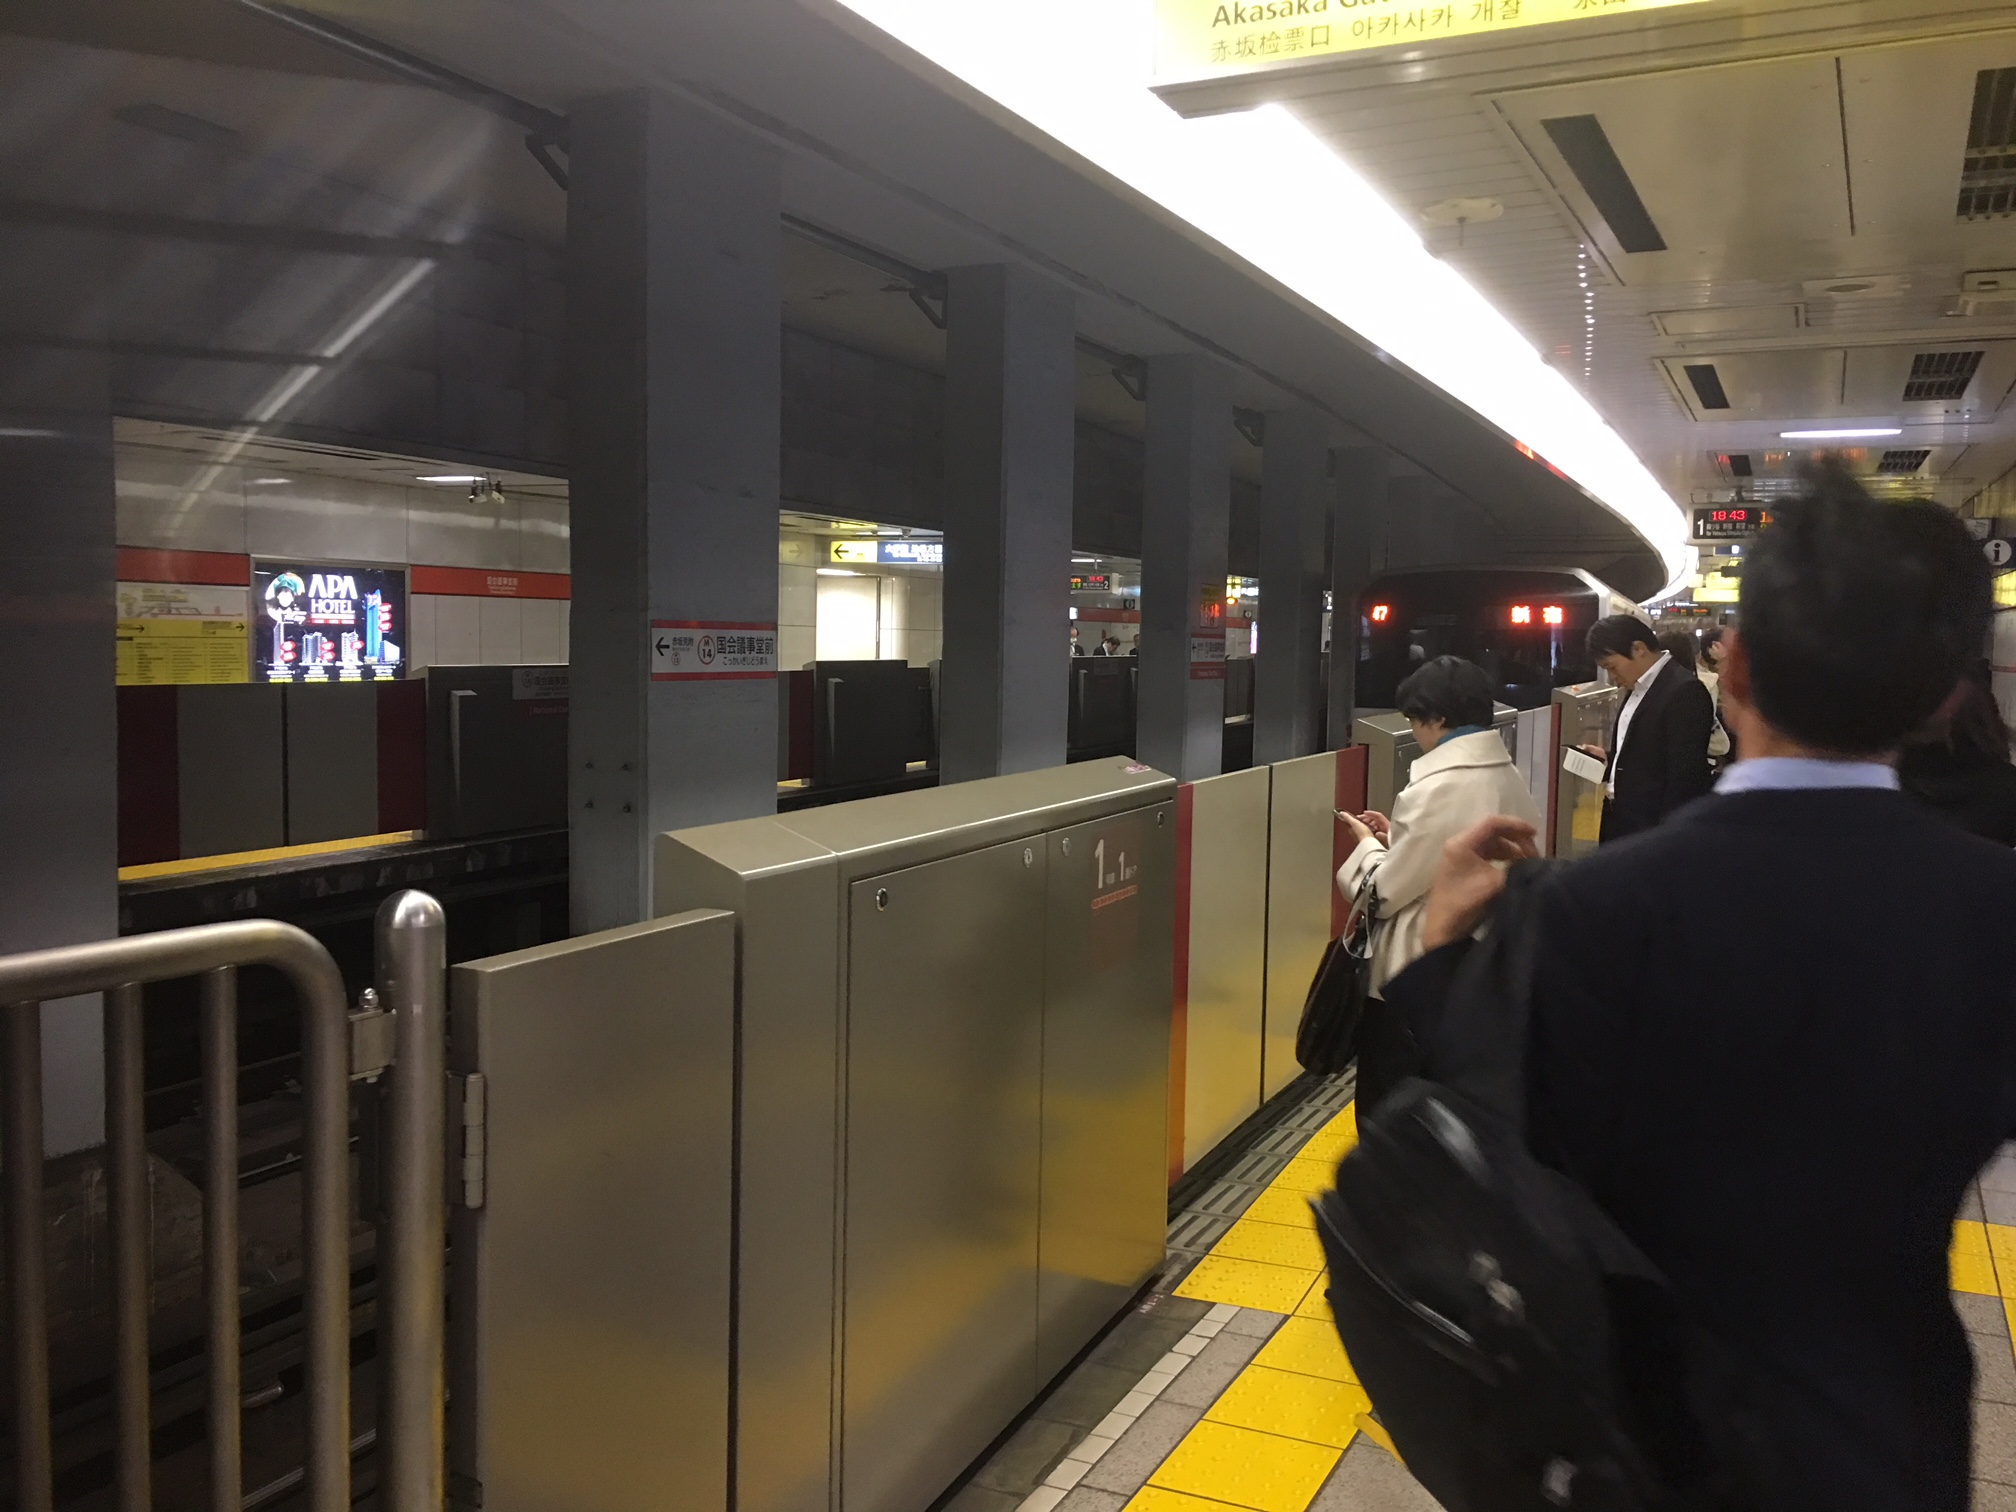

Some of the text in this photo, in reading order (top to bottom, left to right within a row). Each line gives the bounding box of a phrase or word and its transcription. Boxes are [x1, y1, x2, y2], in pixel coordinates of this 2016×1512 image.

[1212, 0, 1328, 28] Akasaka
[1352, 4, 1453, 39] 아카사카
[1211, 25, 1330, 63] 赤坂检票口
[1697, 518, 1704, 536] 1
[308, 573, 358, 600] APA
[310, 599, 355, 614] HOTEL
[702, 648, 712, 659] 14
[716, 636, 774, 655] 国会議事堂前
